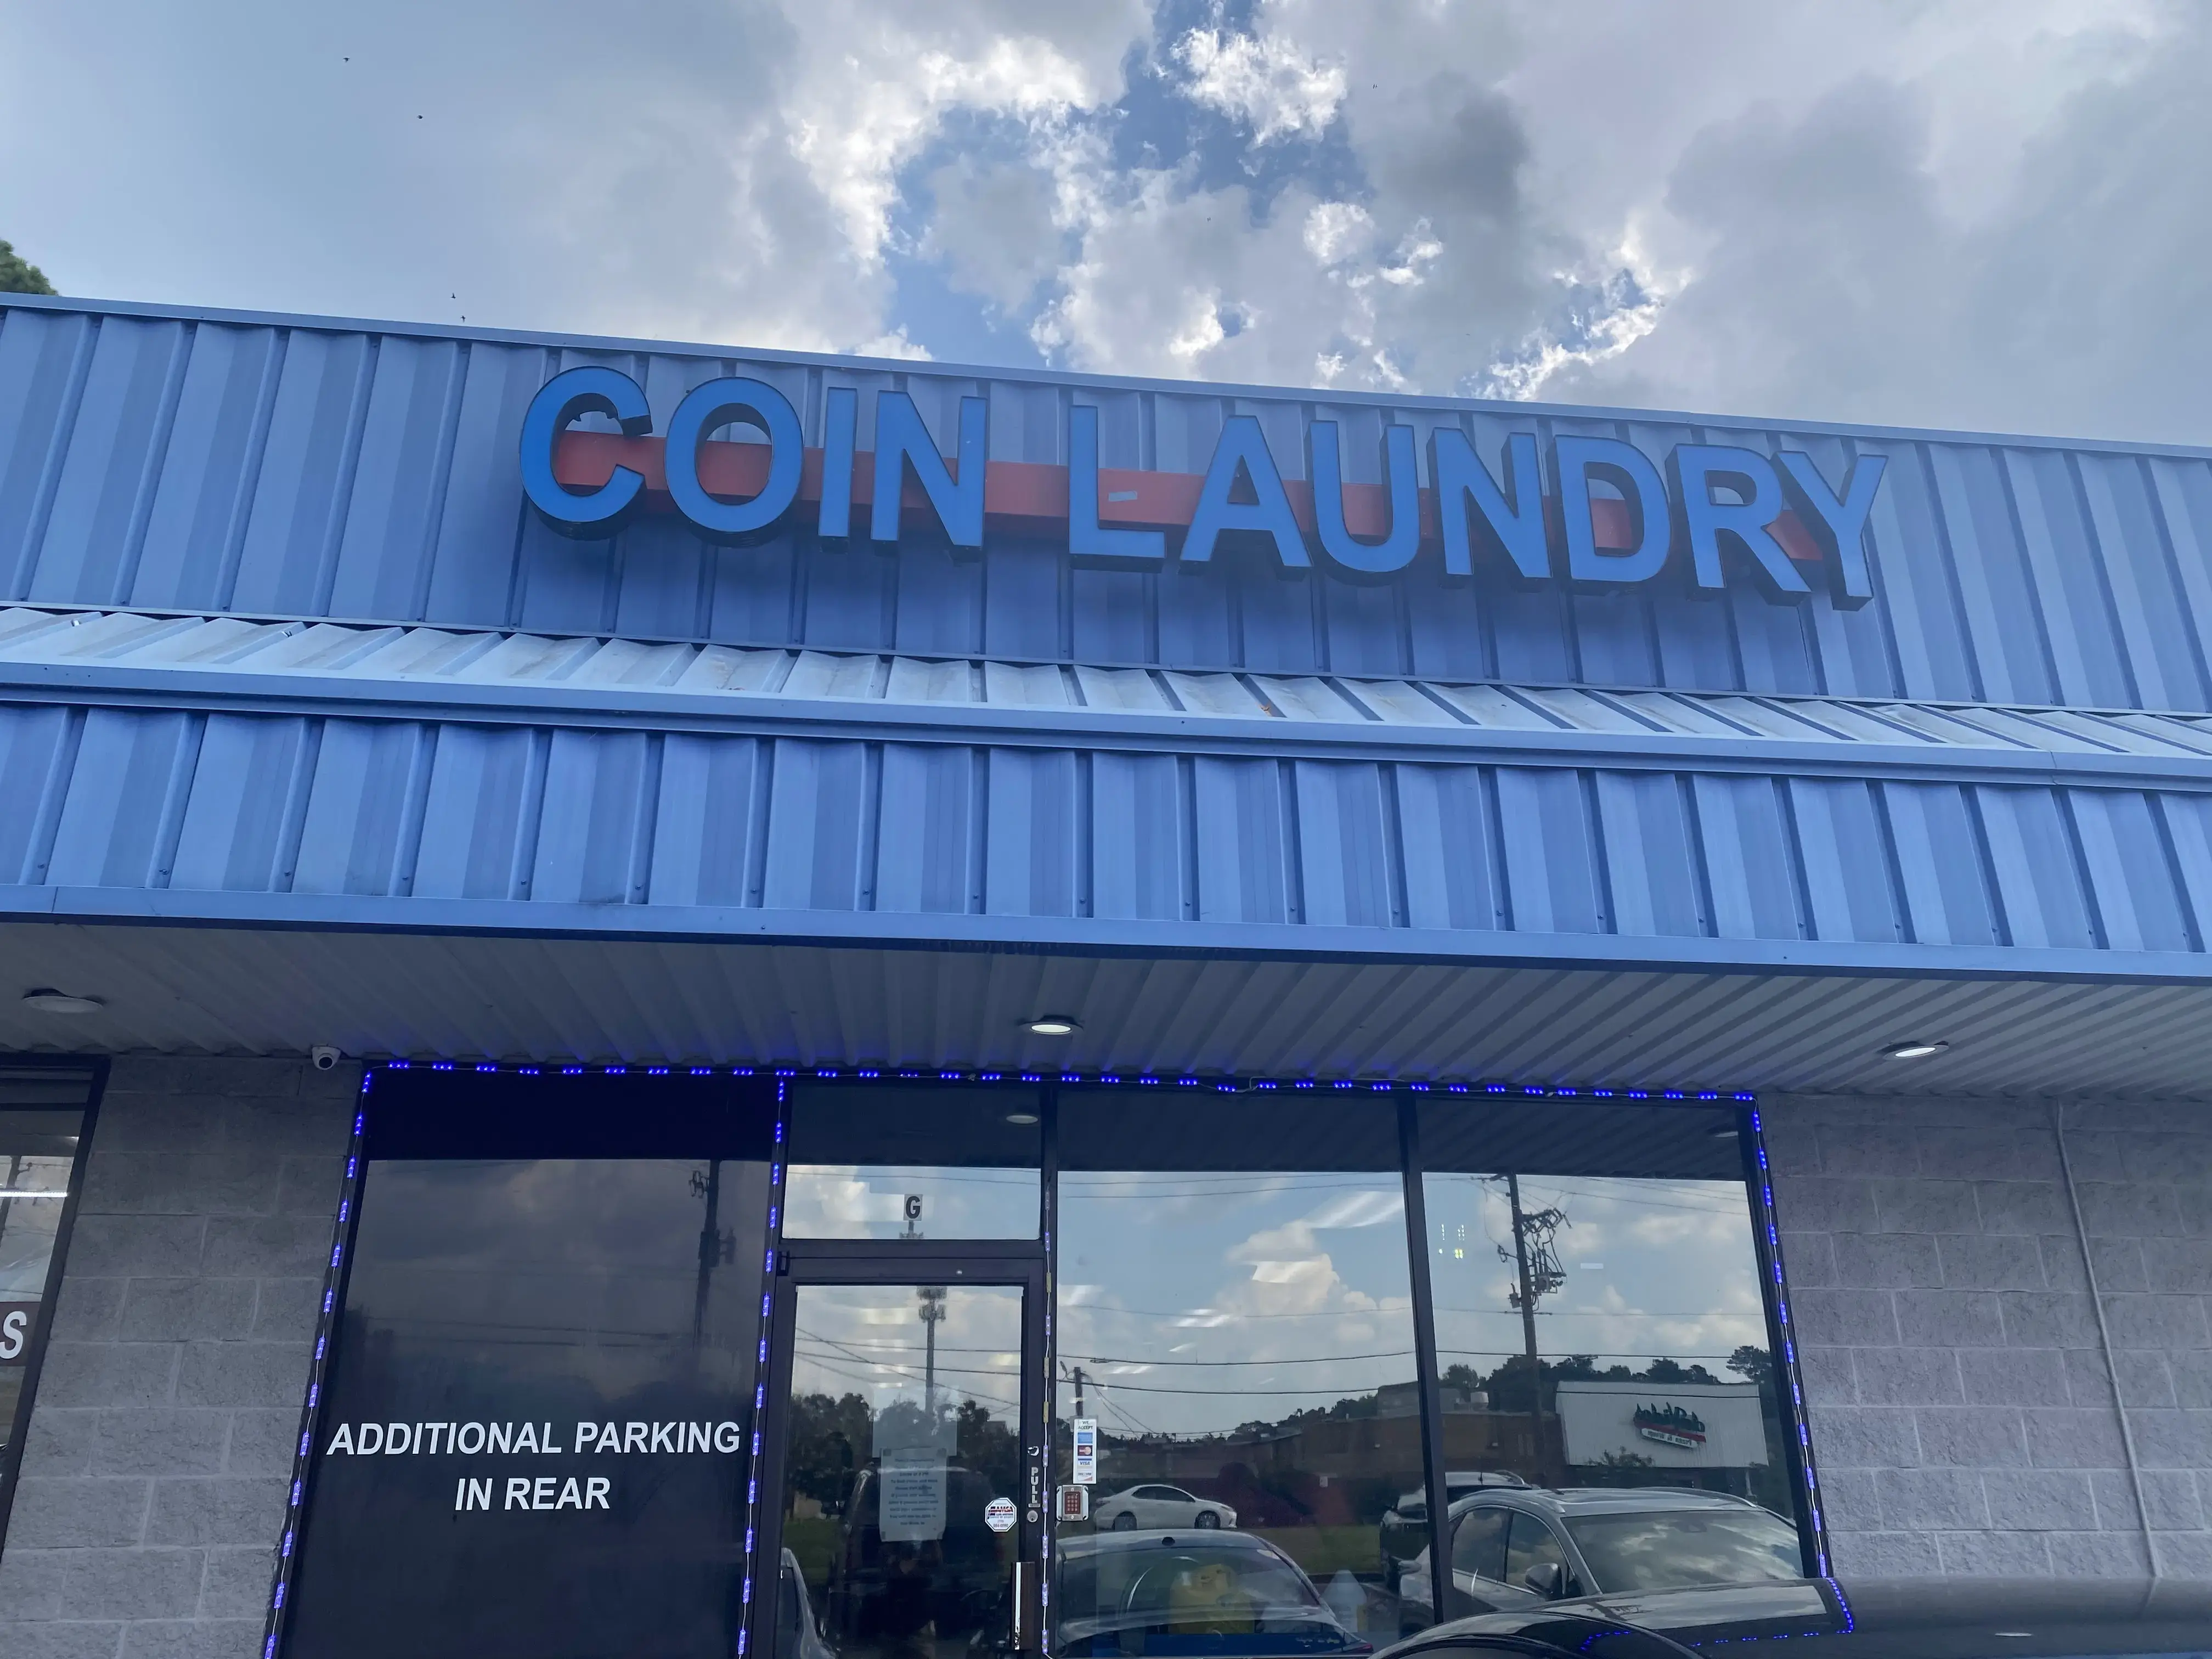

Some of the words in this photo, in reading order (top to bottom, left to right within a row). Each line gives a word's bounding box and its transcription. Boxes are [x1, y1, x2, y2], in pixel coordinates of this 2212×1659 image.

[520, 365, 988, 553] COIN
[1069, 405, 1888, 606] LAUNDRY
[906, 1196, 920, 1218] G
[0, 1311, 26, 1359] S
[326, 1423, 561, 1455] ADDITIONAL
[574, 1421, 740, 1453] PARKING
[455, 1478, 492, 1510] IN
[504, 1477, 611, 1510] REAR
